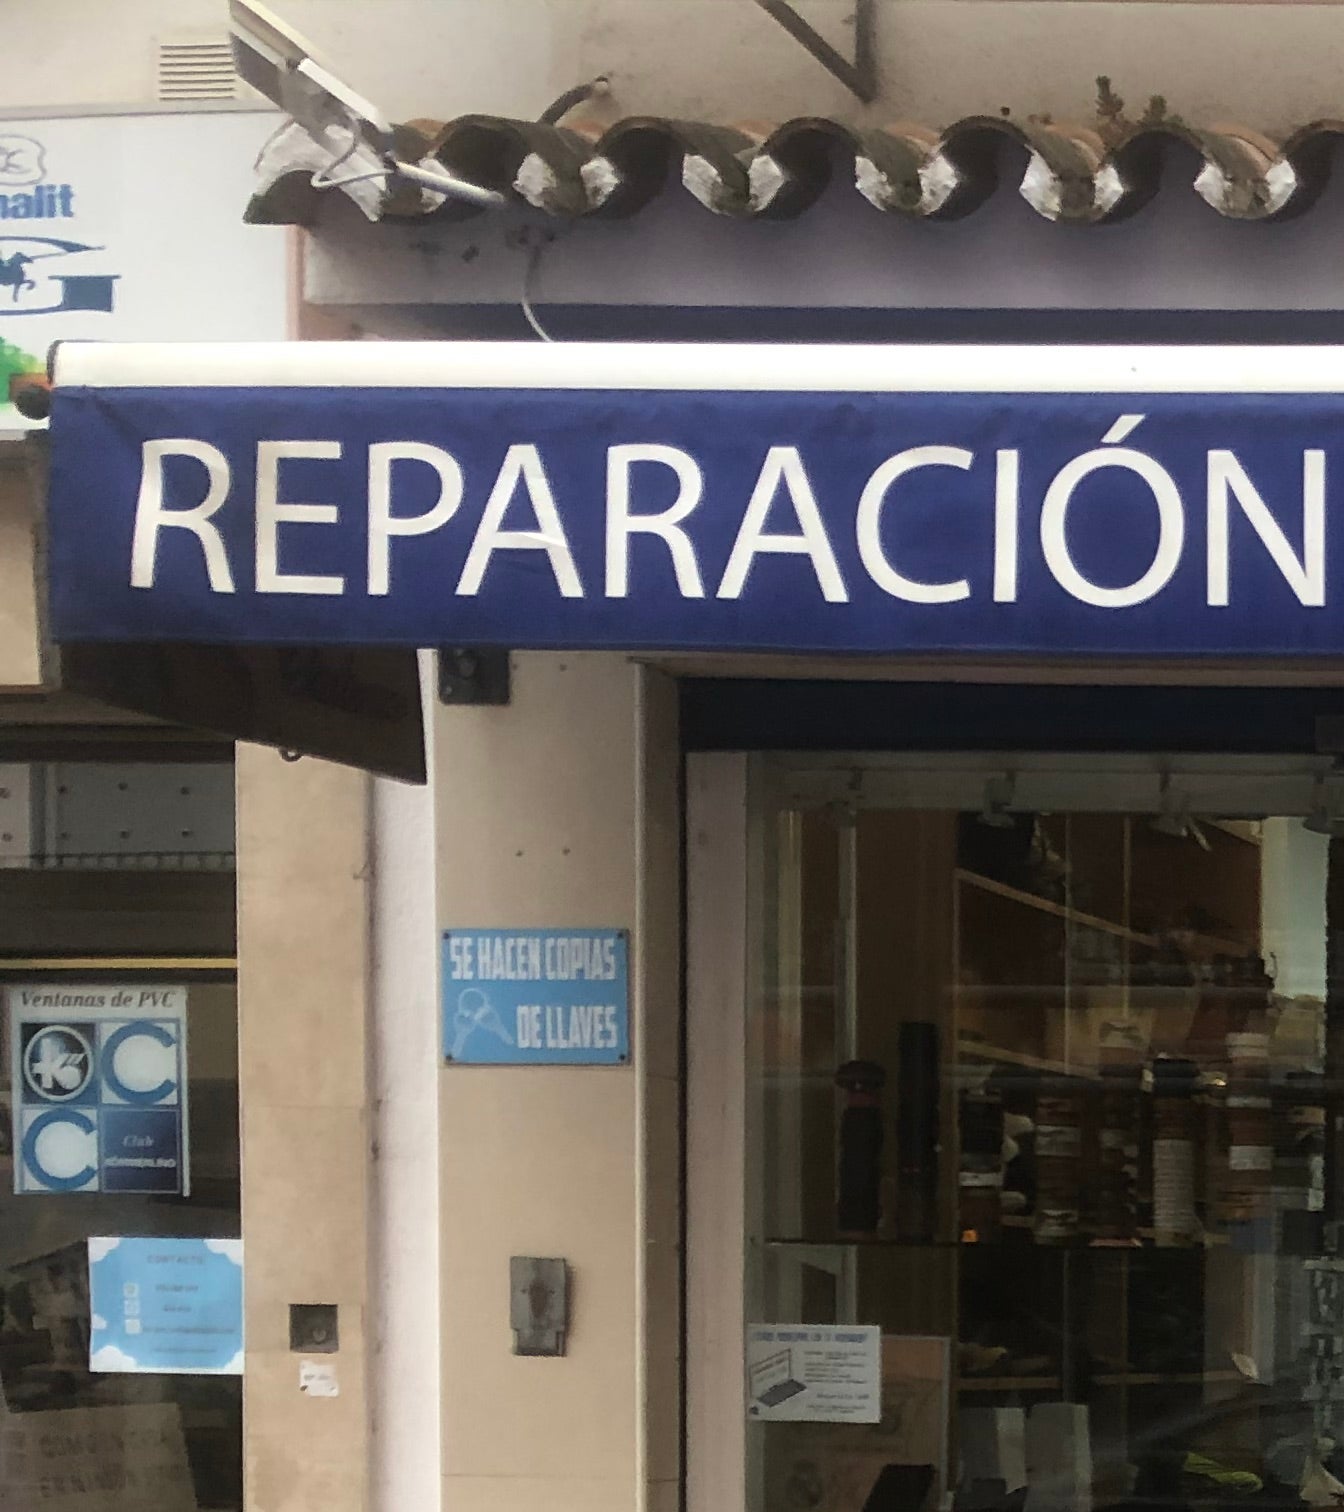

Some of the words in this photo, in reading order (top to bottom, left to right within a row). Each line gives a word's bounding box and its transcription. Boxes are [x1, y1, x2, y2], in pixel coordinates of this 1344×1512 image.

[132, 415, 1325, 607] REPARACIÓN
[450, 937, 473, 980] SE
[477, 937, 540, 980] HACEN
[545, 937, 616, 980] COPIAS
[21, 991, 105, 1008] Ventanas
[110, 991, 132, 1008] de
[138, 991, 176, 1008] PVC
[516, 1005, 542, 1049] DE
[546, 1005, 618, 1048] LLAVES
